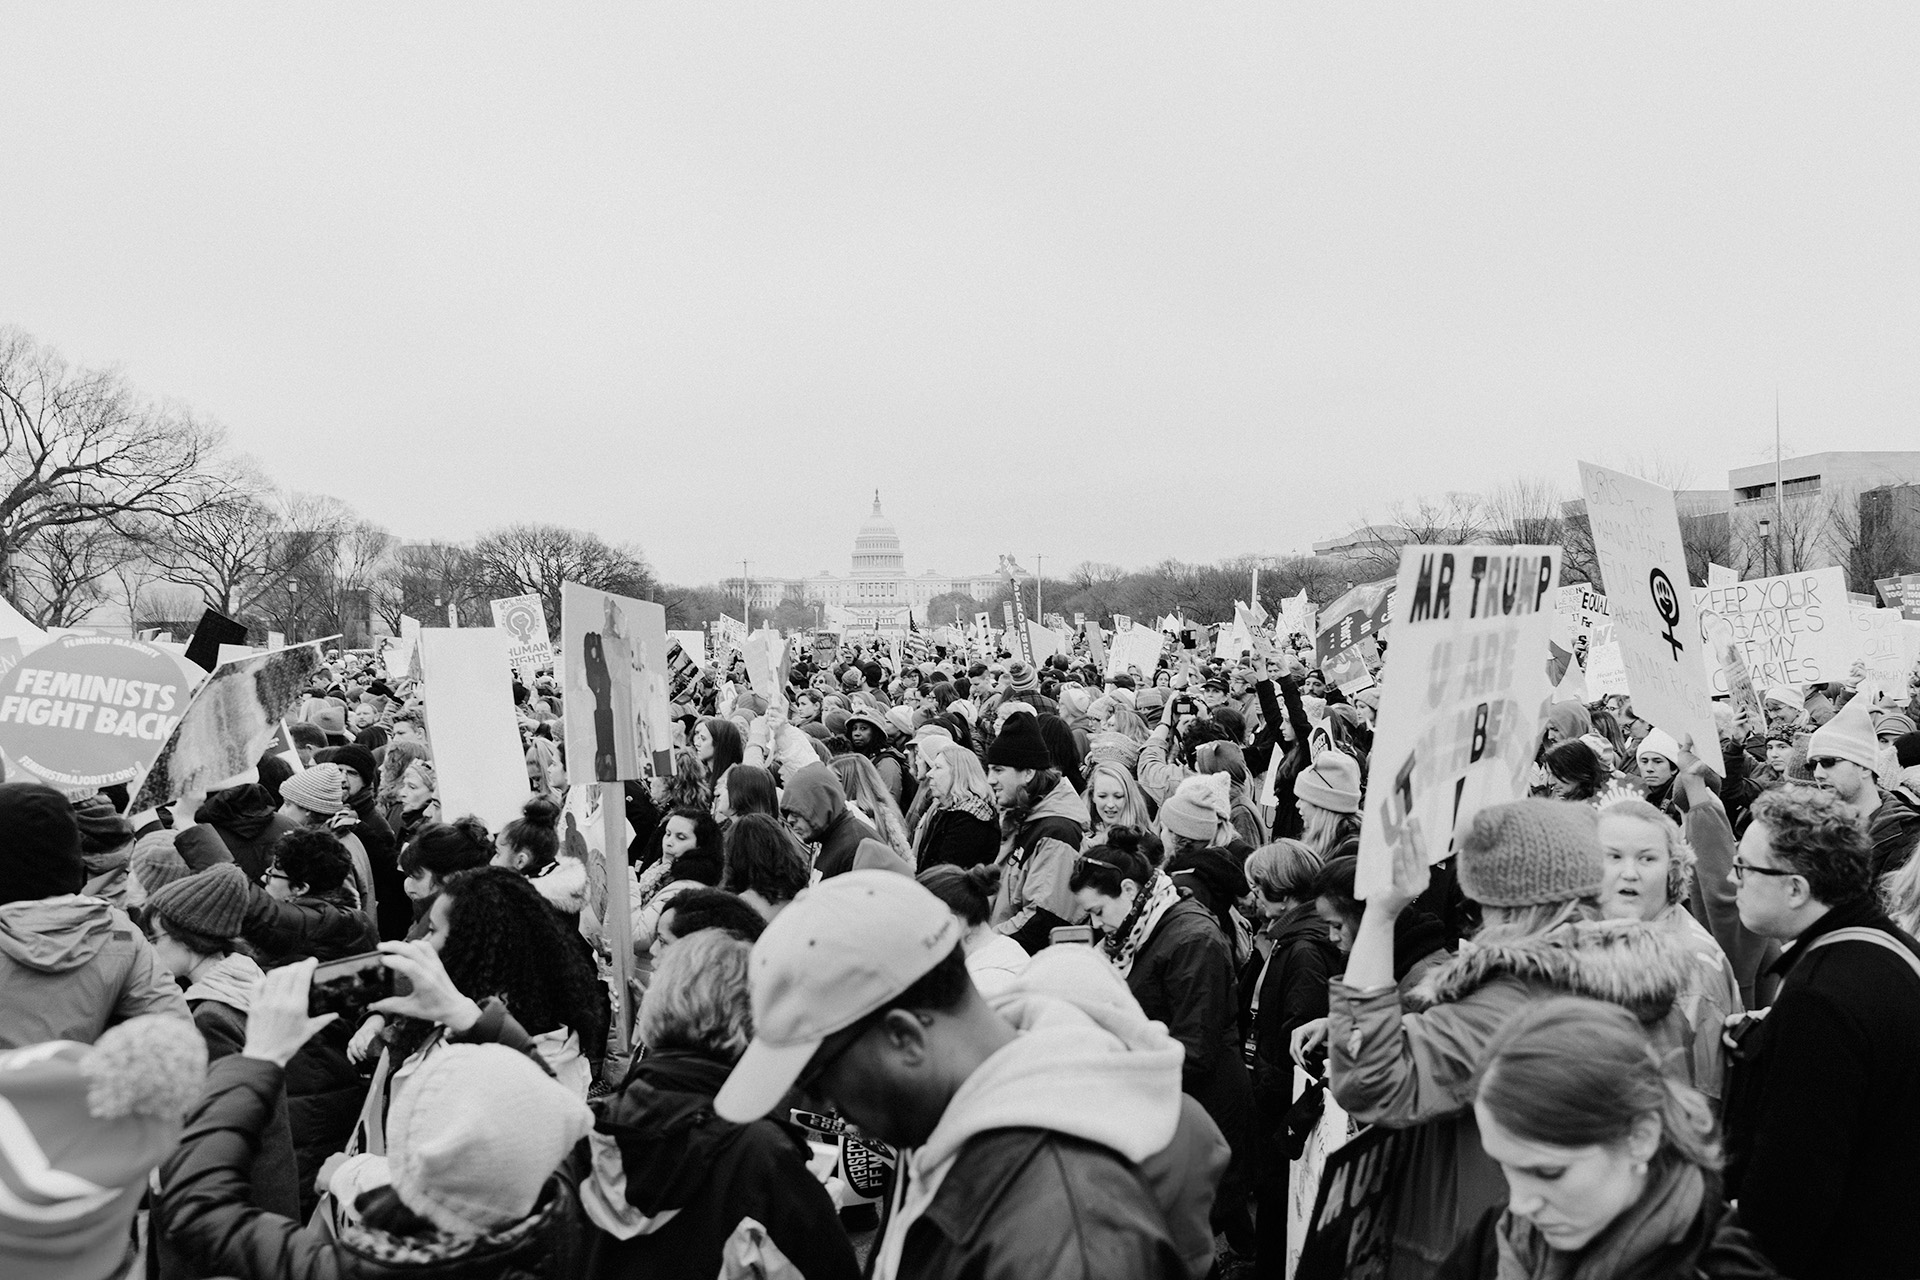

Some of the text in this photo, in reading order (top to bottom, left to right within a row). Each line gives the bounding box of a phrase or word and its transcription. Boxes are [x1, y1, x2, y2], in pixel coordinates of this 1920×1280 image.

[1409, 552, 1552, 623] MR TRUMP
[1582, 591, 1610, 617] EQUAL
[1695, 586, 1748, 613] KEEP
[1755, 577, 1822, 611] YOUR
[63, 636, 161, 659] FEMINIST MAJORITY
[1459, 628, 1519, 701] ARE
[1769, 633, 1797, 662] MY
[15, 668, 177, 712] FEMINISTS
[1712, 657, 1821, 692] OARIES
[0, 695, 180, 741] FIGHT BACK
[18, 755, 138, 786] FEMINISTMAJORITY.ORG
